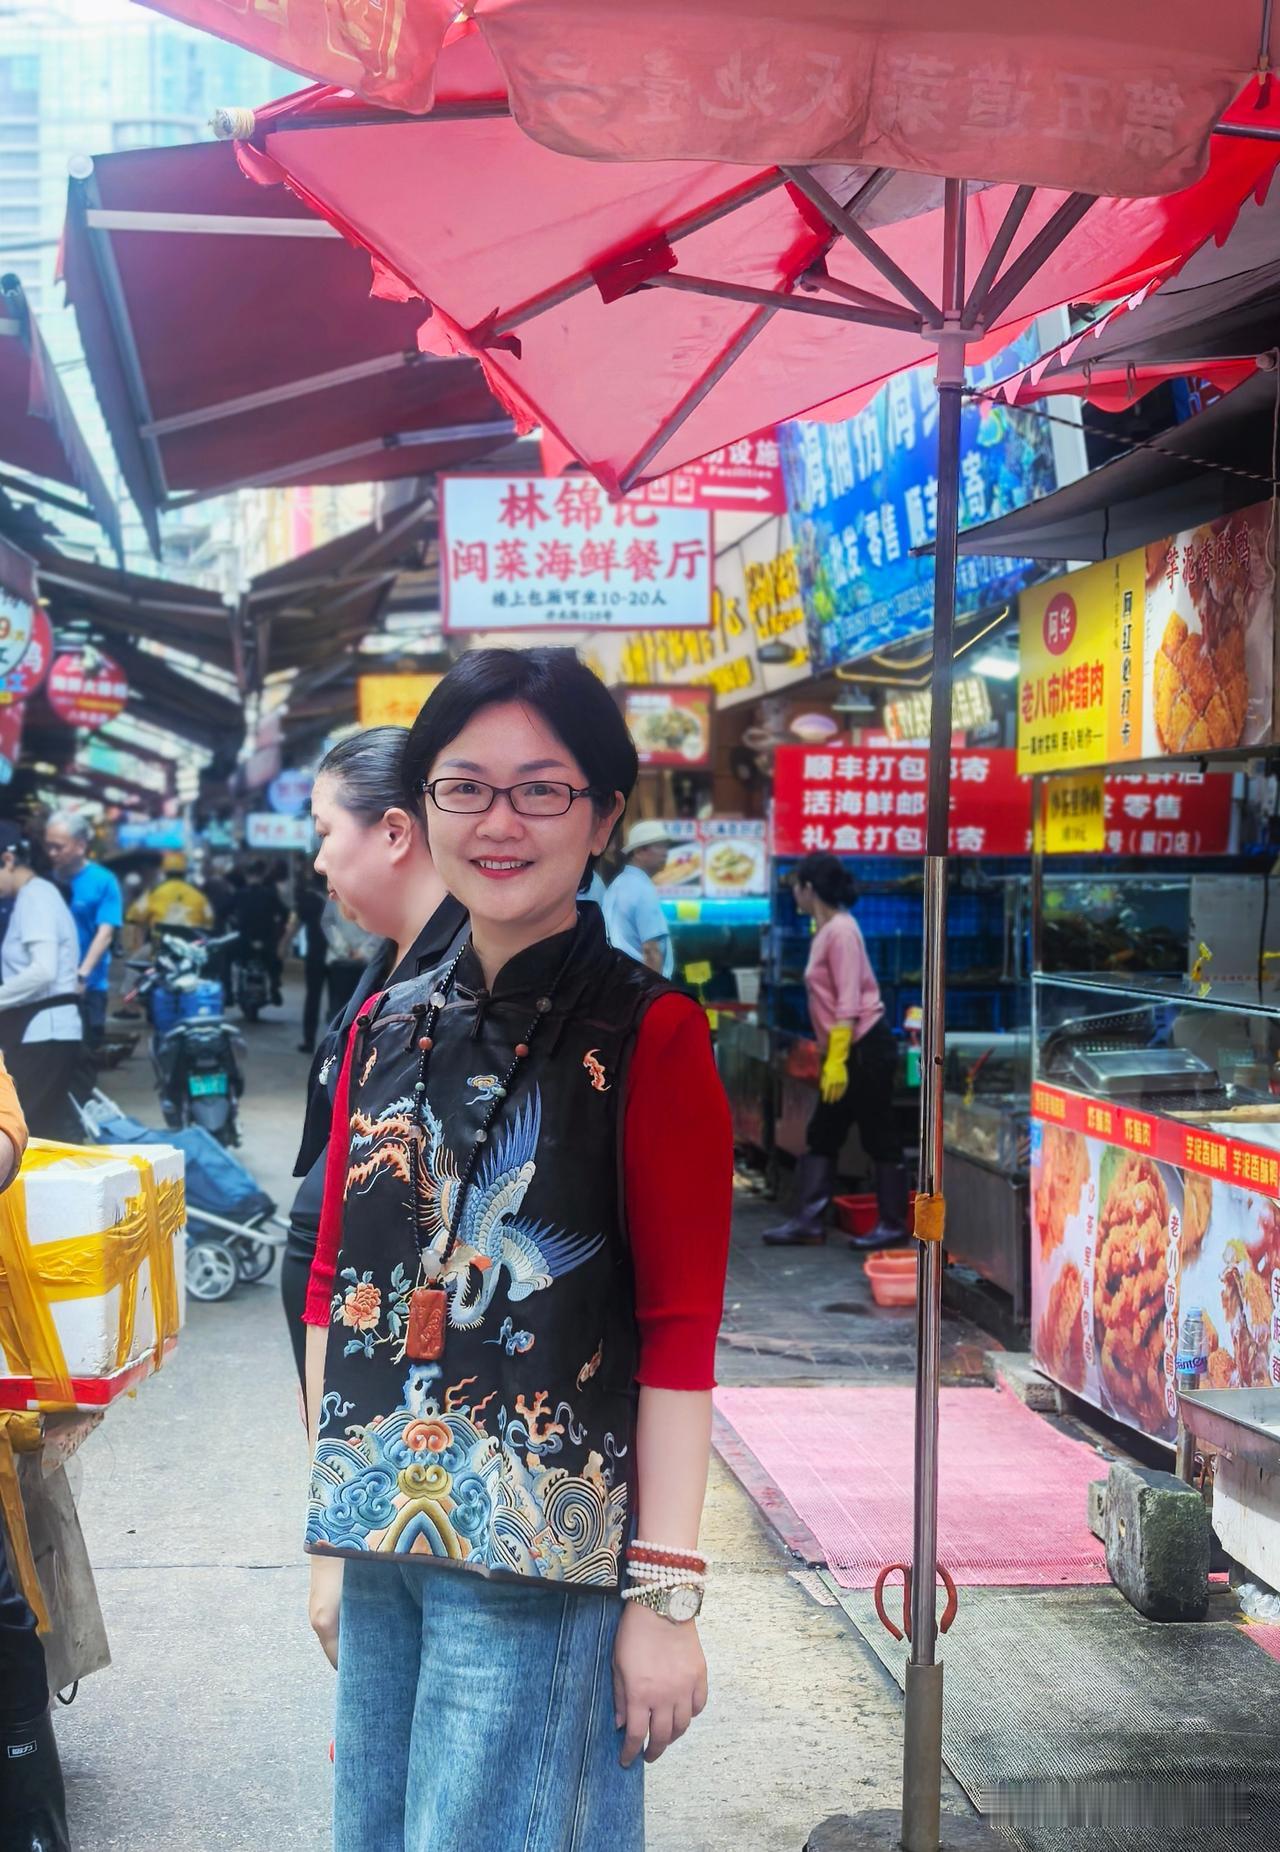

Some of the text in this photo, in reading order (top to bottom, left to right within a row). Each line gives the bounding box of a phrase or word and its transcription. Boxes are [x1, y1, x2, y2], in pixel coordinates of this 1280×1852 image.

[451, 539, 707, 583] 闽菜海鲜餐厅
[1047, 607, 1071, 645] 阿华
[1021, 659, 1105, 724] 老八市炸醋肉
[804, 755, 990, 783] 顺丰打包寄
[803, 790, 957, 817] 活海鲜邮
[1123, 794, 1182, 819] 零售
[801, 826, 985, 852] 礼盒打包寄
[1105, 831, 1200, 853] 号（厦门店）
[1185, 1135, 1228, 1172] 芋泥香酥鸭
